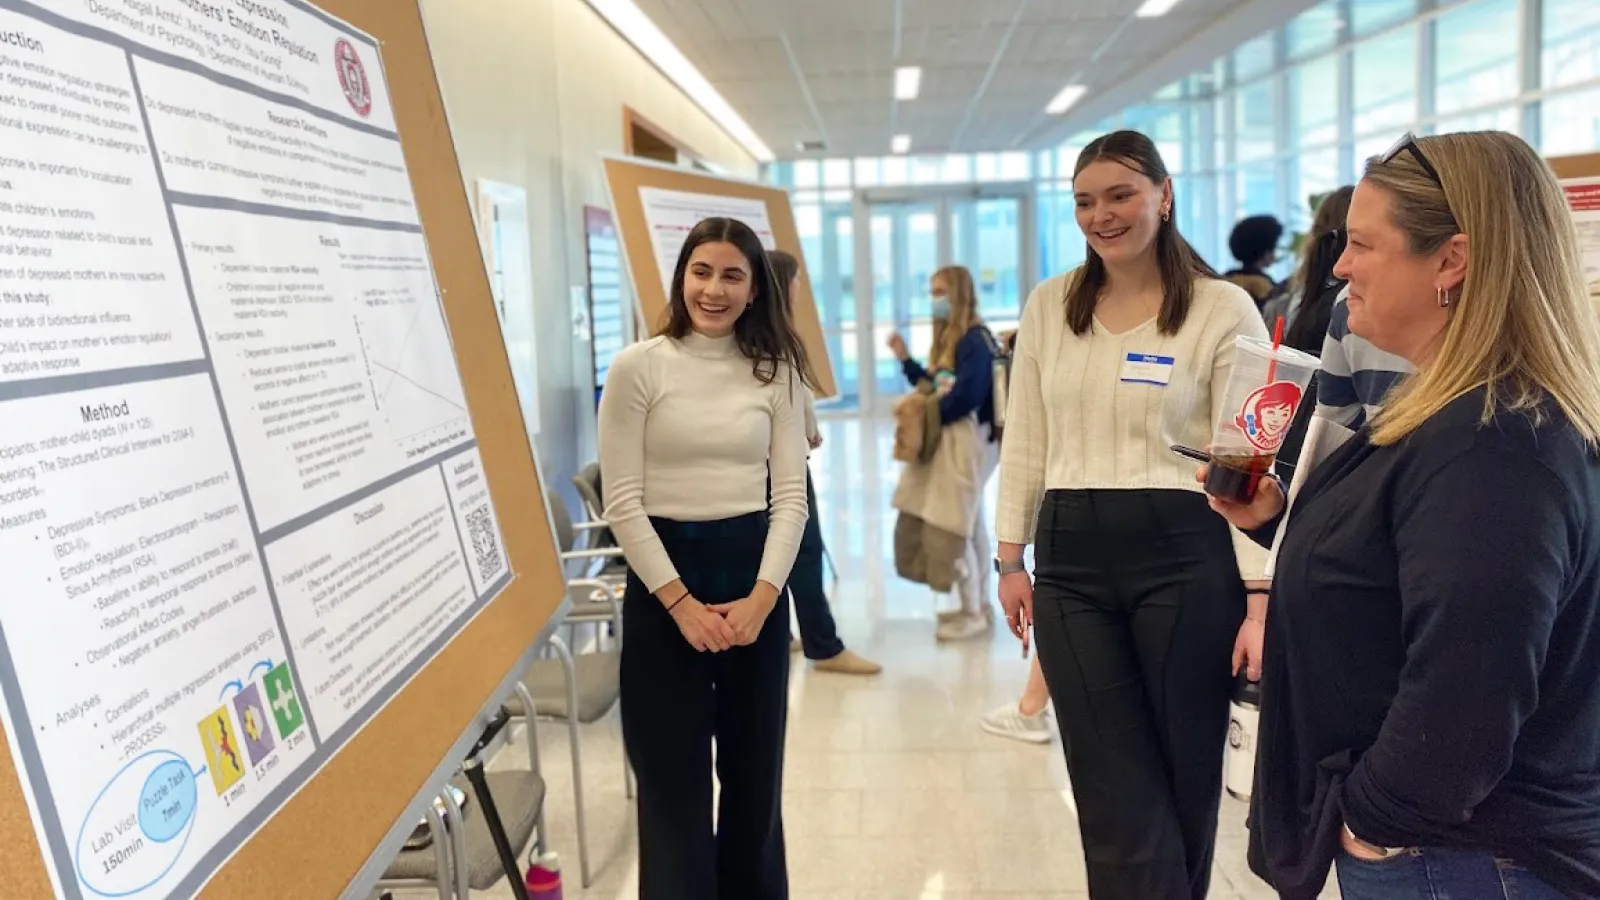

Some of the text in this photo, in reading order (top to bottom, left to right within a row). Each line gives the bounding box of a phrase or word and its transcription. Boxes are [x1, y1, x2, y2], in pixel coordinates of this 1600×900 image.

[0, 30, 44, 54] uction
[80, 399, 130, 423] Method
[0, 440, 38, 460] cipants:
[0, 465, 37, 485] eening:
[38, 459, 56, 475] The
[57, 449, 100, 470] Structured
[47, 514, 95, 541] Depressive
[59, 556, 96, 582] Emotion
[54, 692, 103, 728] Analyses
[142, 767, 188, 812] Puzzle Task
[229, 783, 247, 799] min
[90, 812, 140, 854] Lab Visit
[100, 834, 146, 875] 150min
